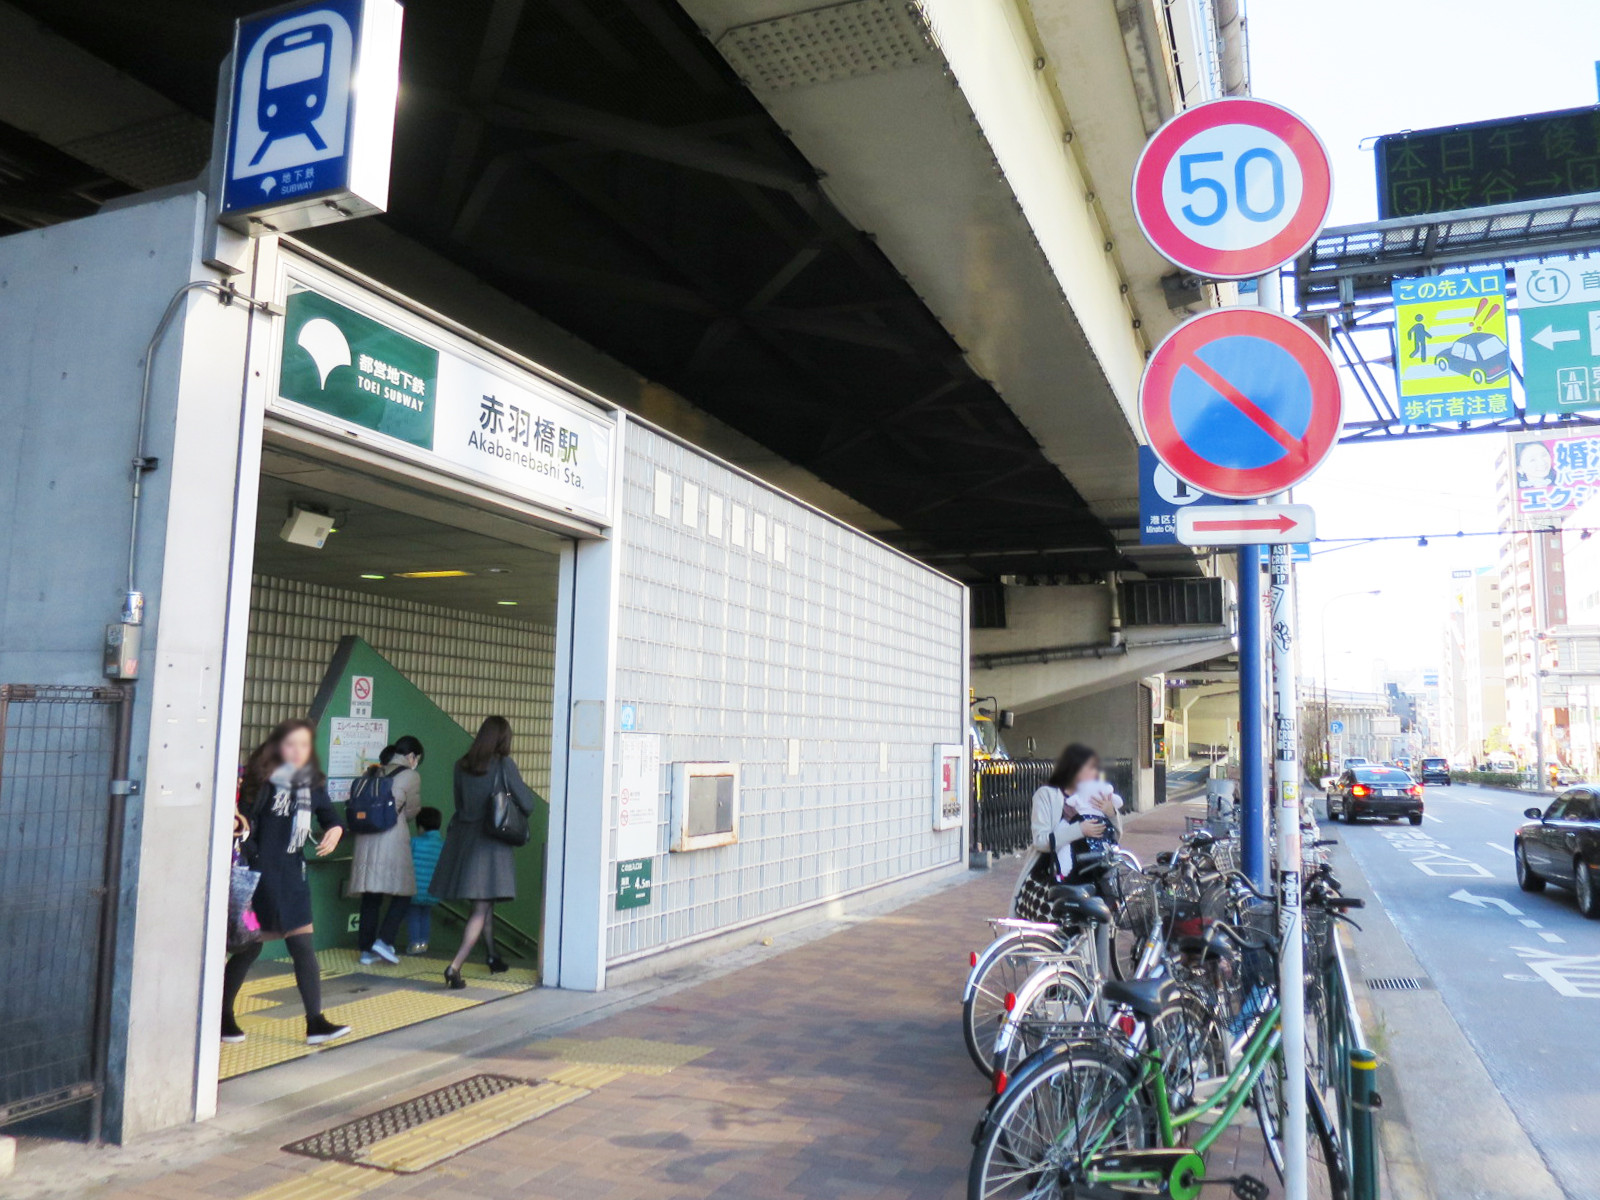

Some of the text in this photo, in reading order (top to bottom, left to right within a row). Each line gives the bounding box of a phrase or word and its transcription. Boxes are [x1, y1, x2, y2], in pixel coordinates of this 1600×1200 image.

[1391, 116, 1600, 178] 本日午後
[281, 167, 315, 183] 地下鉄
[281, 180, 314, 195] SUBWAY
[1179, 147, 1285, 227] 50
[1399, 275, 1500, 300] この先入口
[1534, 275, 1560, 295] C1
[358, 353, 425, 396] 都営地下鉄
[357, 375, 425, 413] TOEI SUBWAY
[1404, 394, 1508, 420] 歩行者注意
[479, 393, 579, 467] 赤羽橋駅
[467, 430, 585, 490] Akabanebashi Sta.
[1145, 525, 1165, 534] Minato
